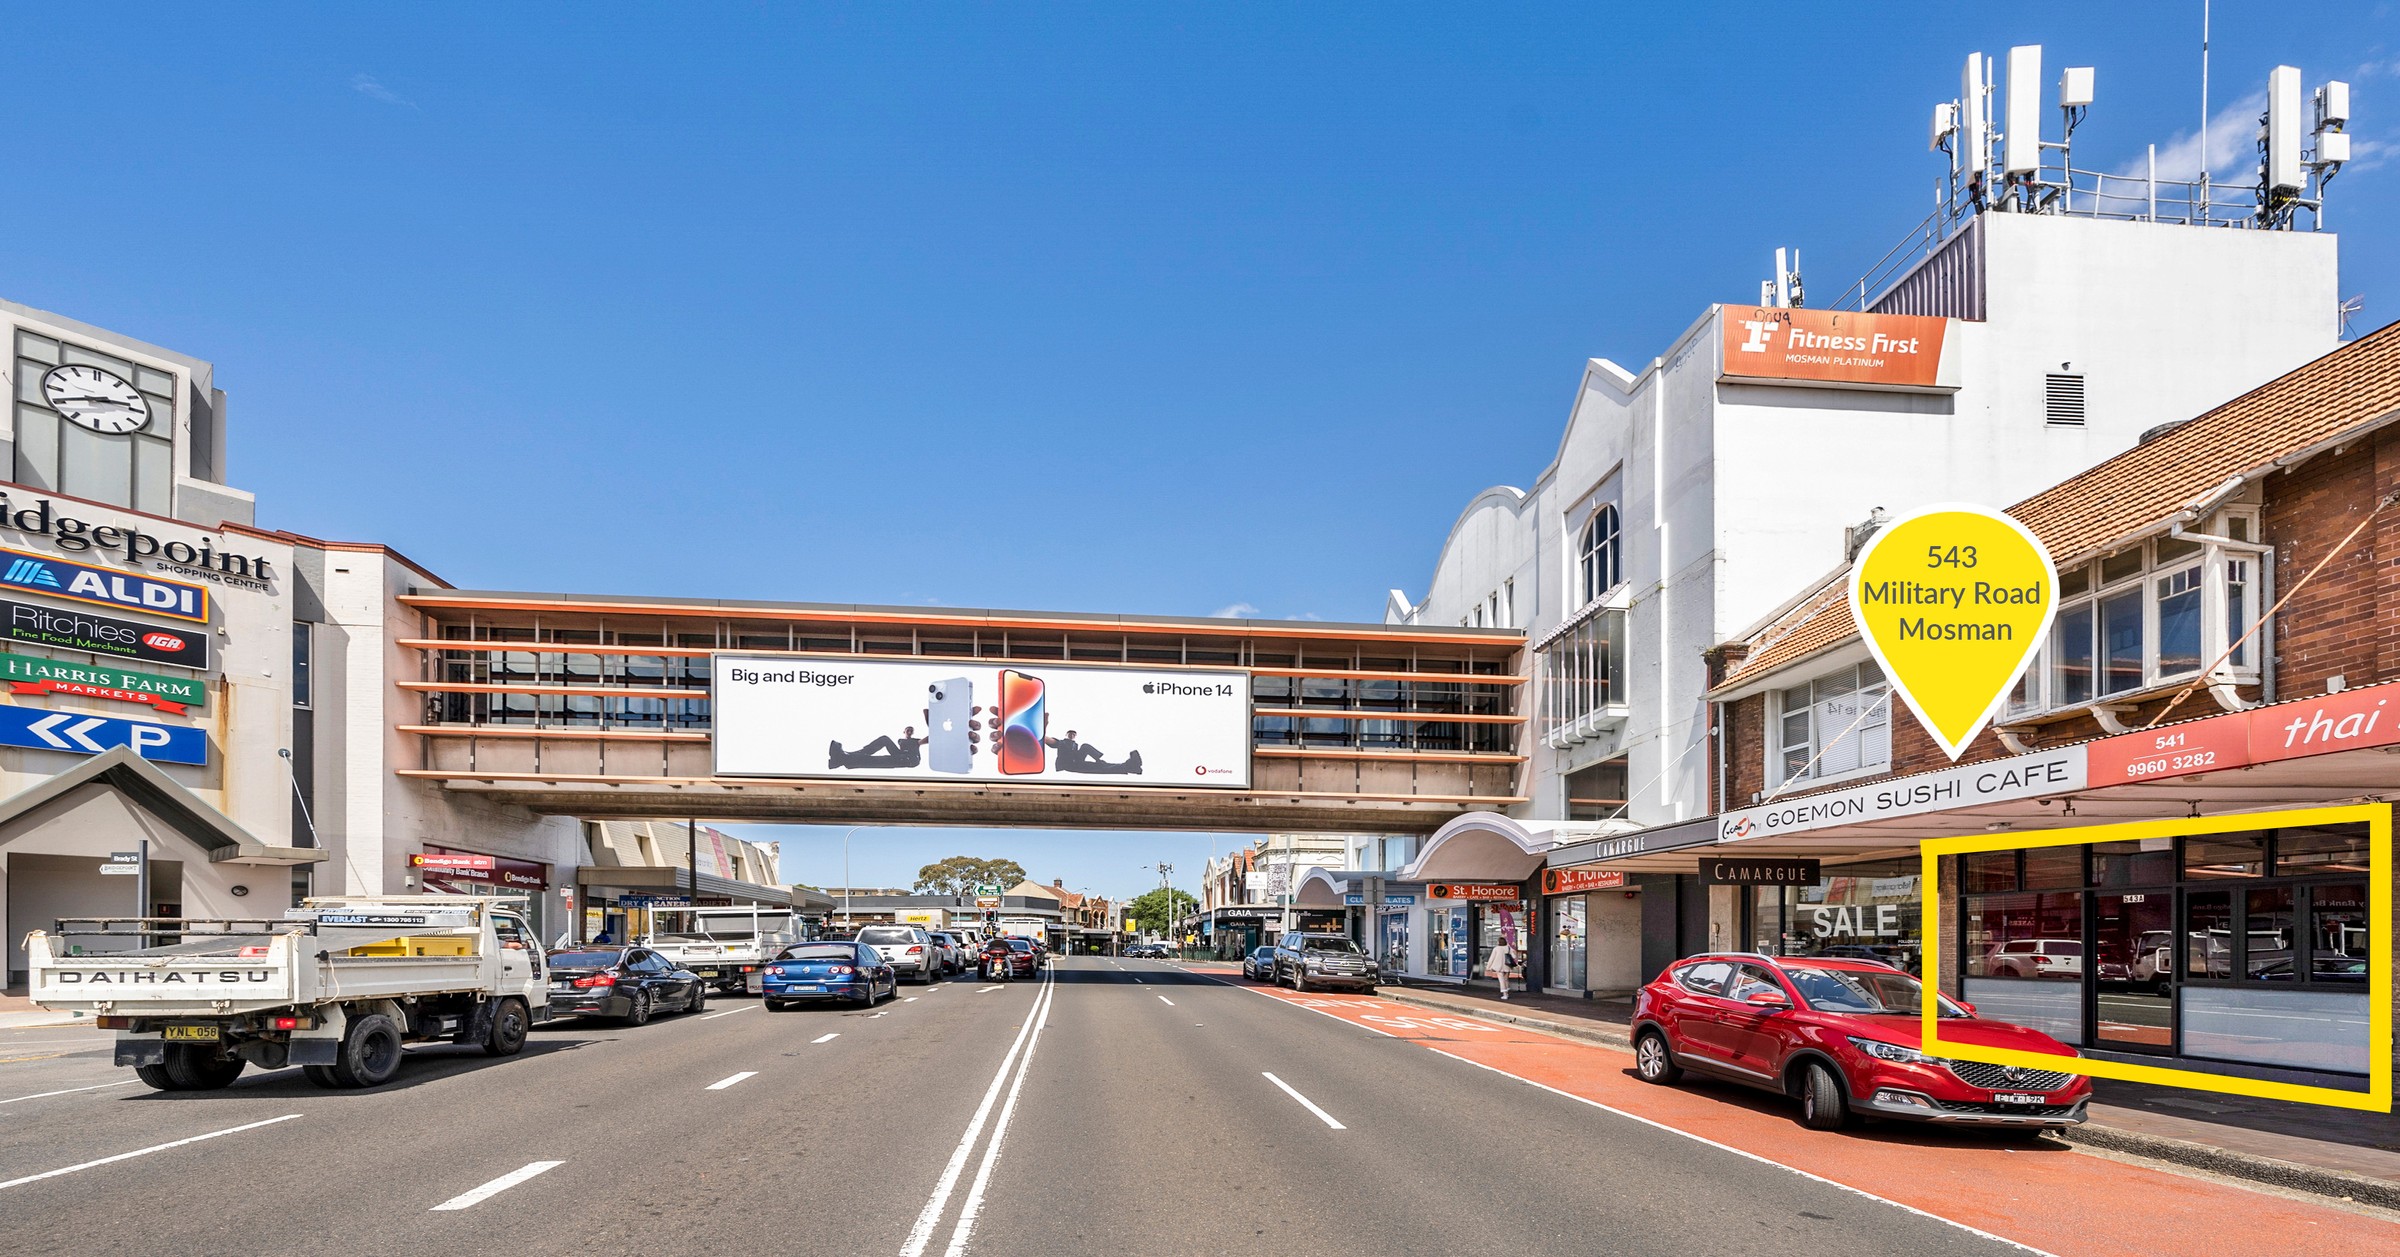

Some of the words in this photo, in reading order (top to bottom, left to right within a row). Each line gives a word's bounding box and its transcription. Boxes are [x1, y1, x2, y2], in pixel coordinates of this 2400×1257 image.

[1787, 328, 1866, 351] Fitness
[1871, 333, 1919, 354] First
[1785, 353, 1830, 365] MOSMAN
[1833, 357, 1884, 368] PLATINUM
[156, 562, 221, 582] SHOPPING
[223, 576, 269, 591] CENTRE
[67, 570, 193, 614] ALDI
[12, 605, 137, 644] Ritchies
[12, 628, 39, 640] Fine
[42, 632, 73, 644] Food
[76, 638, 137, 655] Merchants
[147, 635, 181, 649] IGA
[8, 659, 111, 685] HARRIS
[122, 675, 192, 697] FARM
[731, 668, 759, 685] Big
[762, 670, 795, 683] and
[799, 670, 855, 687] Bigger
[56, 683, 149, 701] MARKETS
[1156, 682, 1213, 696] iPhone
[1215, 684, 1233, 697] 14
[2282, 698, 2387, 749] thai
[131, 724, 171, 755] P
[2155, 733, 2186, 750] 541
[2126, 758, 2167, 777] 9960
[2172, 751, 2216, 770] 3282
[1765, 797, 1864, 829] GOEMON
[1876, 779, 1961, 810] SUSHI
[1976, 760, 2070, 795] CAFE
[1596, 837, 1645, 857] CAMARGUE
[1714, 863, 1807, 881] CAMARGUE
[1453, 886, 1468, 895] St.
[1472, 886, 1515, 896] Honoré
[2123, 895, 2144, 904] 543A
[1813, 904, 1899, 938] SALE
[58, 970, 269, 984] DAIHATSU
[169, 1028, 192, 1036] YNL
[197, 1028, 216, 1036] 058
